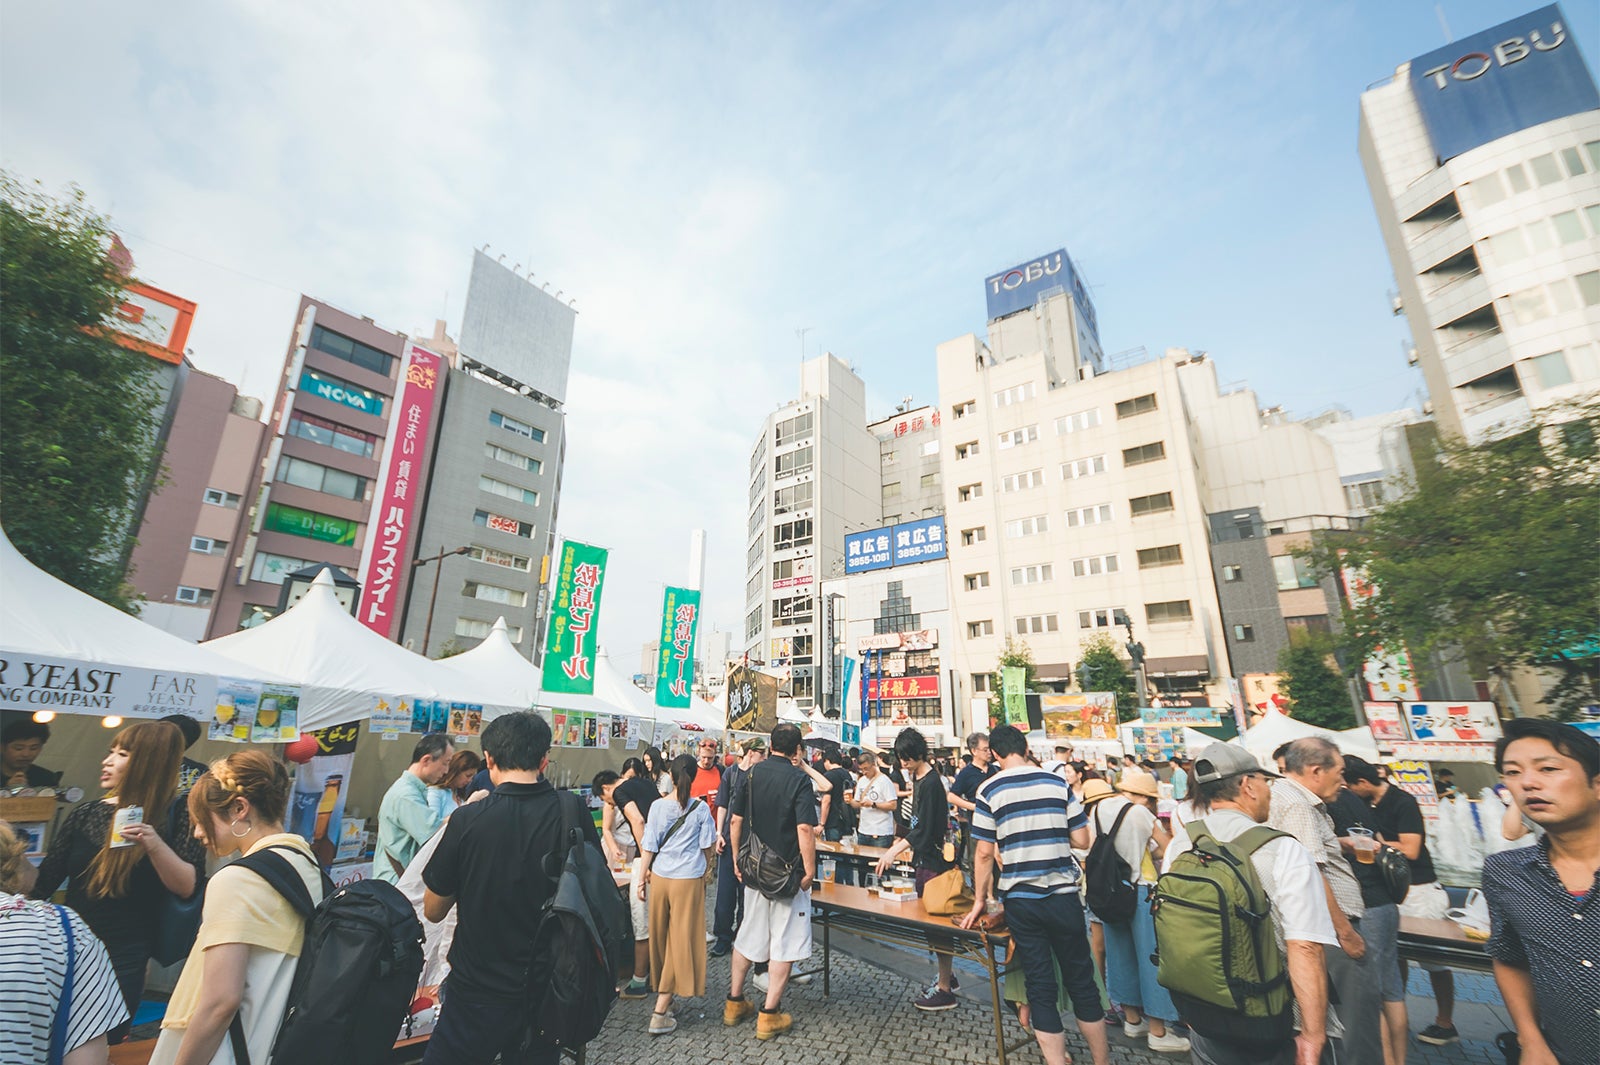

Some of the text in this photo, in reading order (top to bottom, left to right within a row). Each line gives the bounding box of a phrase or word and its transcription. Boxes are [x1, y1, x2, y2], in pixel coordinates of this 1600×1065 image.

[1424, 21, 1566, 90] TOBU
[989, 254, 1062, 294] TOBU
[318, 383, 367, 410] NOVA
[367, 403, 422, 624] 住まい 賃貸 ハウスメイト
[848, 535, 889, 557] 貸広告
[897, 525, 942, 548] 貸広告
[848, 552, 890, 567] 3855-1081
[897, 543, 943, 559] 3855-1081
[23, 661, 121, 694] YEAST
[151, 674, 198, 695] FAR
[28, 689, 116, 709] COMPANY
[148, 691, 198, 706] YEAST
[1412, 714, 1495, 729] フランスビール
